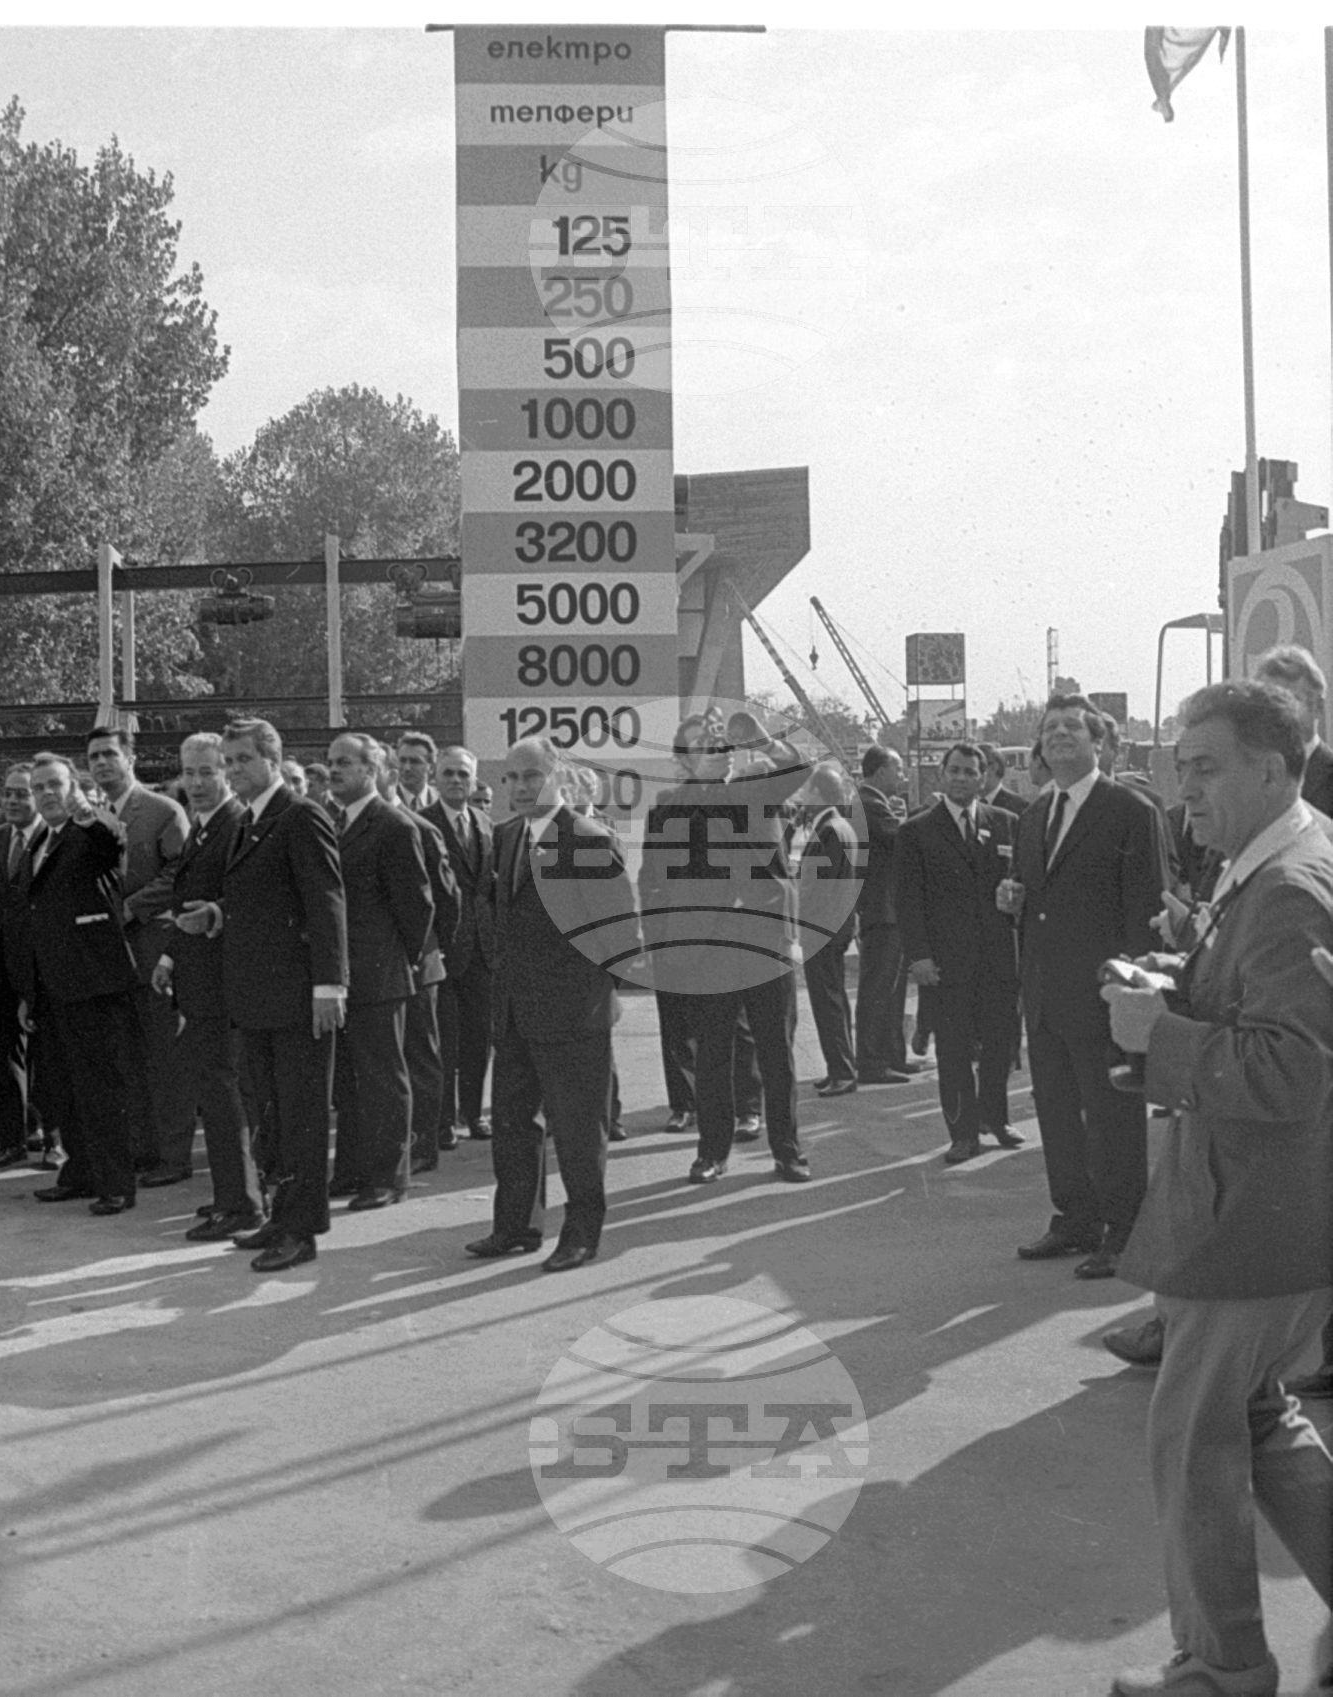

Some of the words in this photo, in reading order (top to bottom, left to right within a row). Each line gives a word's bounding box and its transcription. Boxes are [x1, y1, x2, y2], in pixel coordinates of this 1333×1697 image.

[487, 35, 632, 66] електро
[490, 104, 633, 129] телфери
[540, 154, 582, 193] kg
[552, 215, 632, 256] 125
[543, 275, 634, 319] 250
[543, 336, 635, 380] 500
[520, 397, 637, 441] 1000
[512, 458, 637, 502] 2000
[514, 519, 637, 564] 3200
[516, 582, 640, 626] 5000
[517, 643, 641, 688] 8000
[499, 705, 641, 749] 12500
